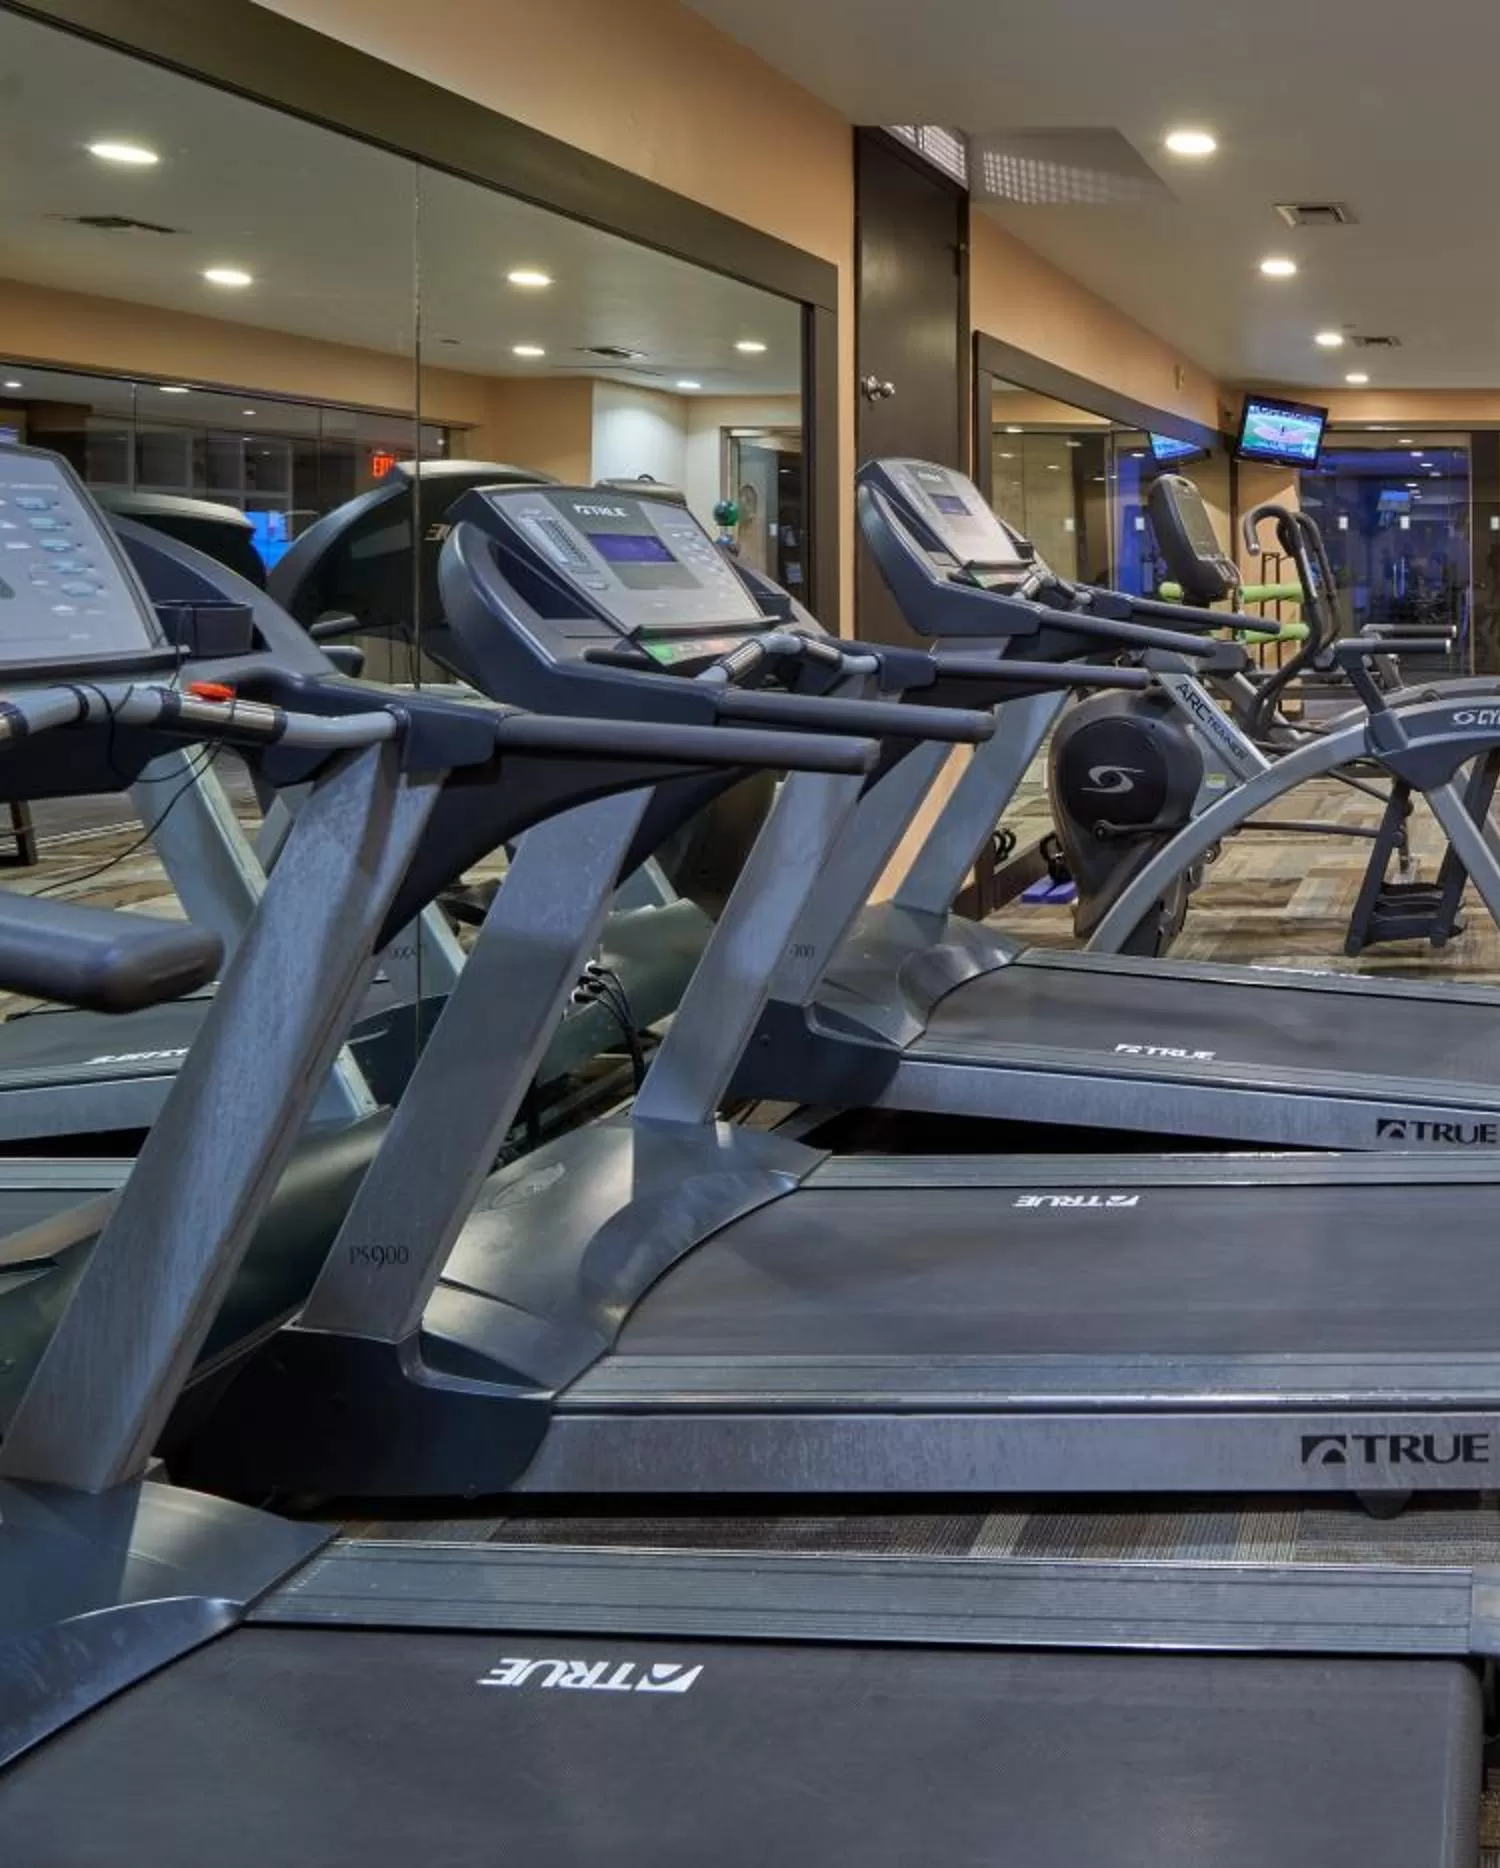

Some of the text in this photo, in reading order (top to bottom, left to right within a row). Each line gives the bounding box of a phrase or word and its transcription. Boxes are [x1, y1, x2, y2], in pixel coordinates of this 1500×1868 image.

[1176, 683, 1211, 721] ARC
[1408, 1121, 1497, 1144] TRUE
[1012, 1195, 1103, 1207] TRUE
[349, 1245, 409, 1270] PS900
[1351, 1434, 1489, 1464] TRUE
[476, 1657, 636, 1690] TRUE
